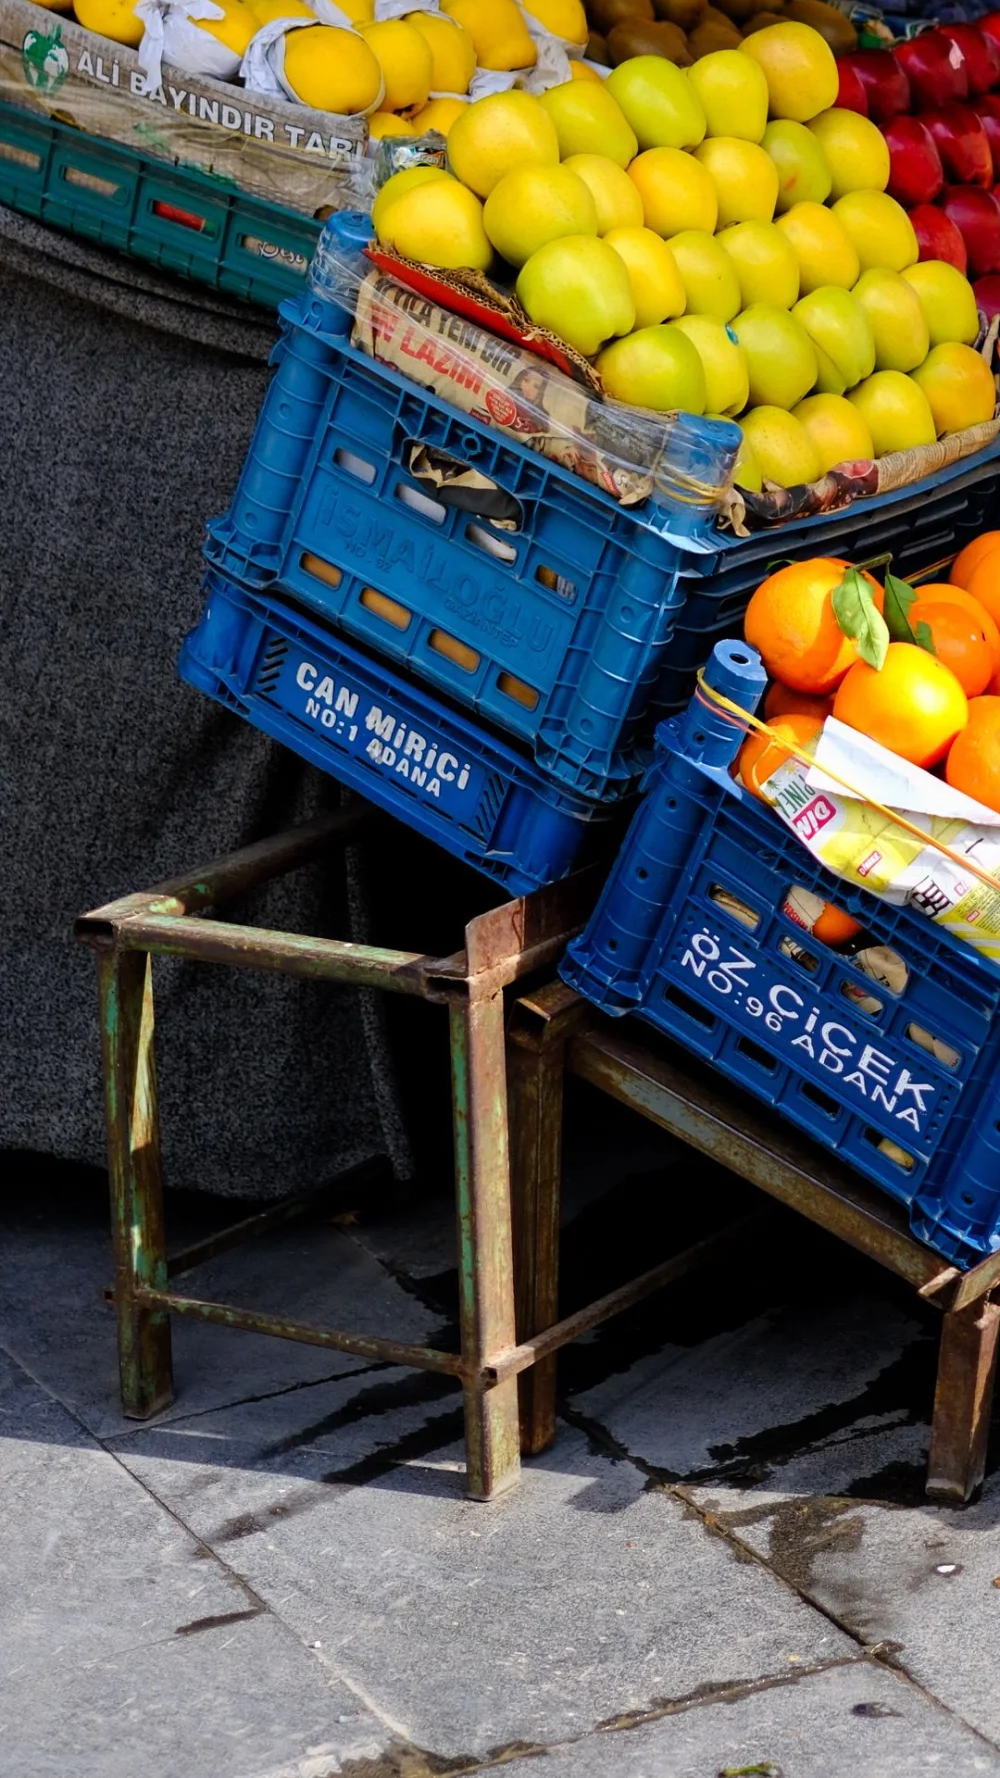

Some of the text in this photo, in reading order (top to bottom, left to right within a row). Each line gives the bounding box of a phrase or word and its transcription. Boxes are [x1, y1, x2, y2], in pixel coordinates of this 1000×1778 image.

[77, 50, 120, 88] ALİ
[130, 72, 276, 143] BAYINDIR
[296, 662, 359, 718] CAN
[305, 698, 441, 798] NO:1 ADANA
[691, 927, 757, 988] ÖZ
[681, 948, 922, 1133] NO:96 ADANA
